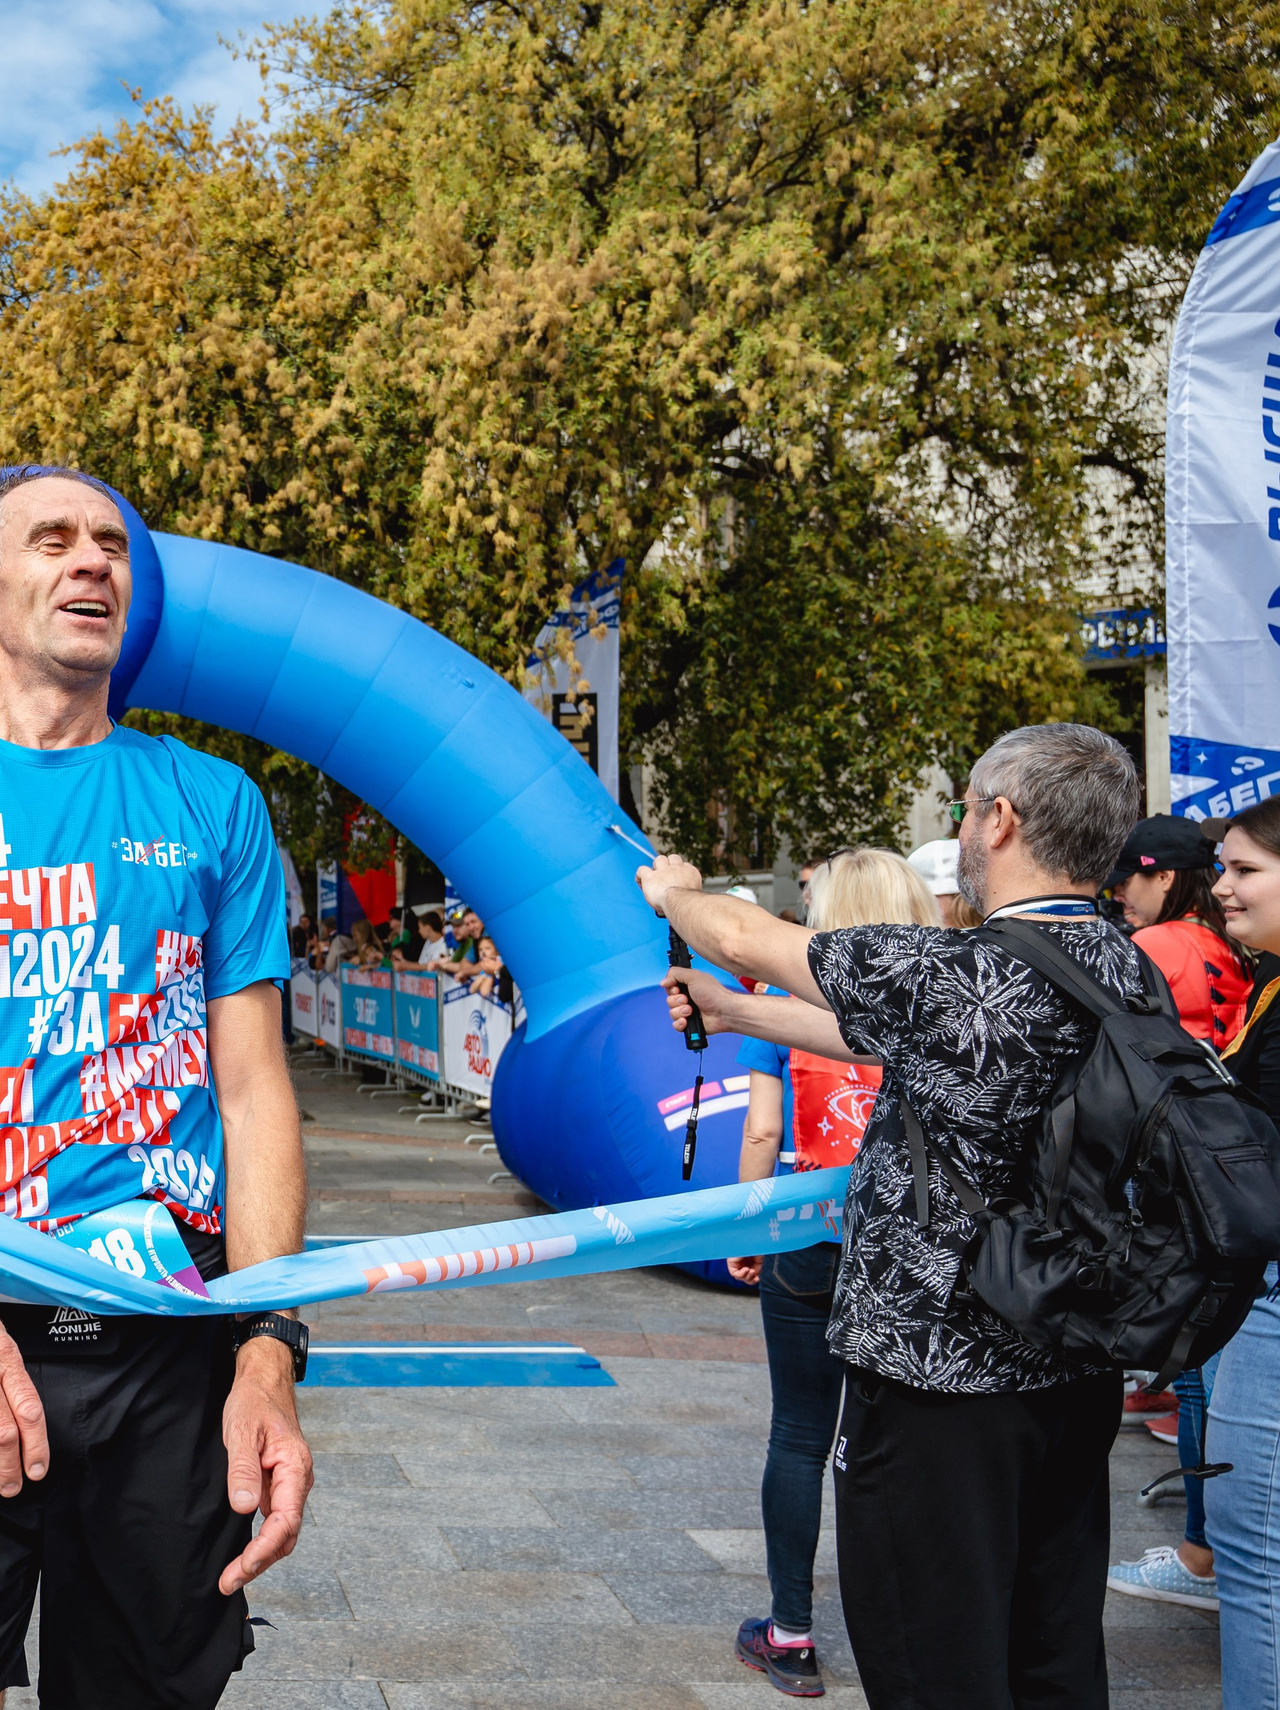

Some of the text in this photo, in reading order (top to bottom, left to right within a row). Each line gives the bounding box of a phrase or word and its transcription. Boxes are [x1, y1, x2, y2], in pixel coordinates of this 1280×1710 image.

[75, 1227, 146, 1280] 18
[48, 1321, 102, 1335] AONIJIE
[54, 1334, 98, 1342] RUNNING
